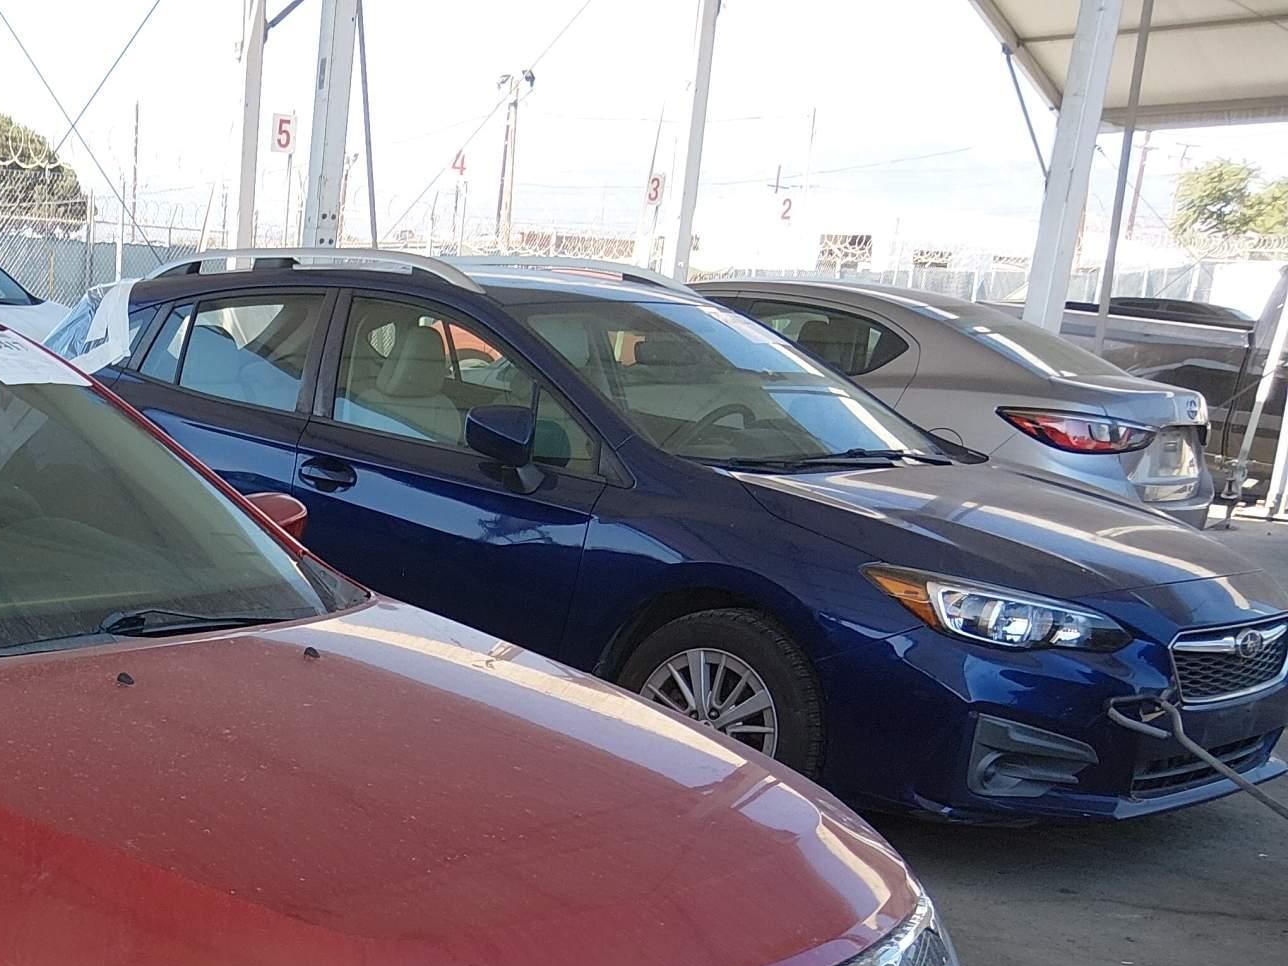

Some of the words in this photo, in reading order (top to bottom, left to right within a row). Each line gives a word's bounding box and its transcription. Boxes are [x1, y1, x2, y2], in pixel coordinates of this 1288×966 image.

[277, 118, 291, 148] 5
[452, 149, 466, 176] 4
[648, 177, 660, 201] 3
[781, 198, 792, 220] 2
